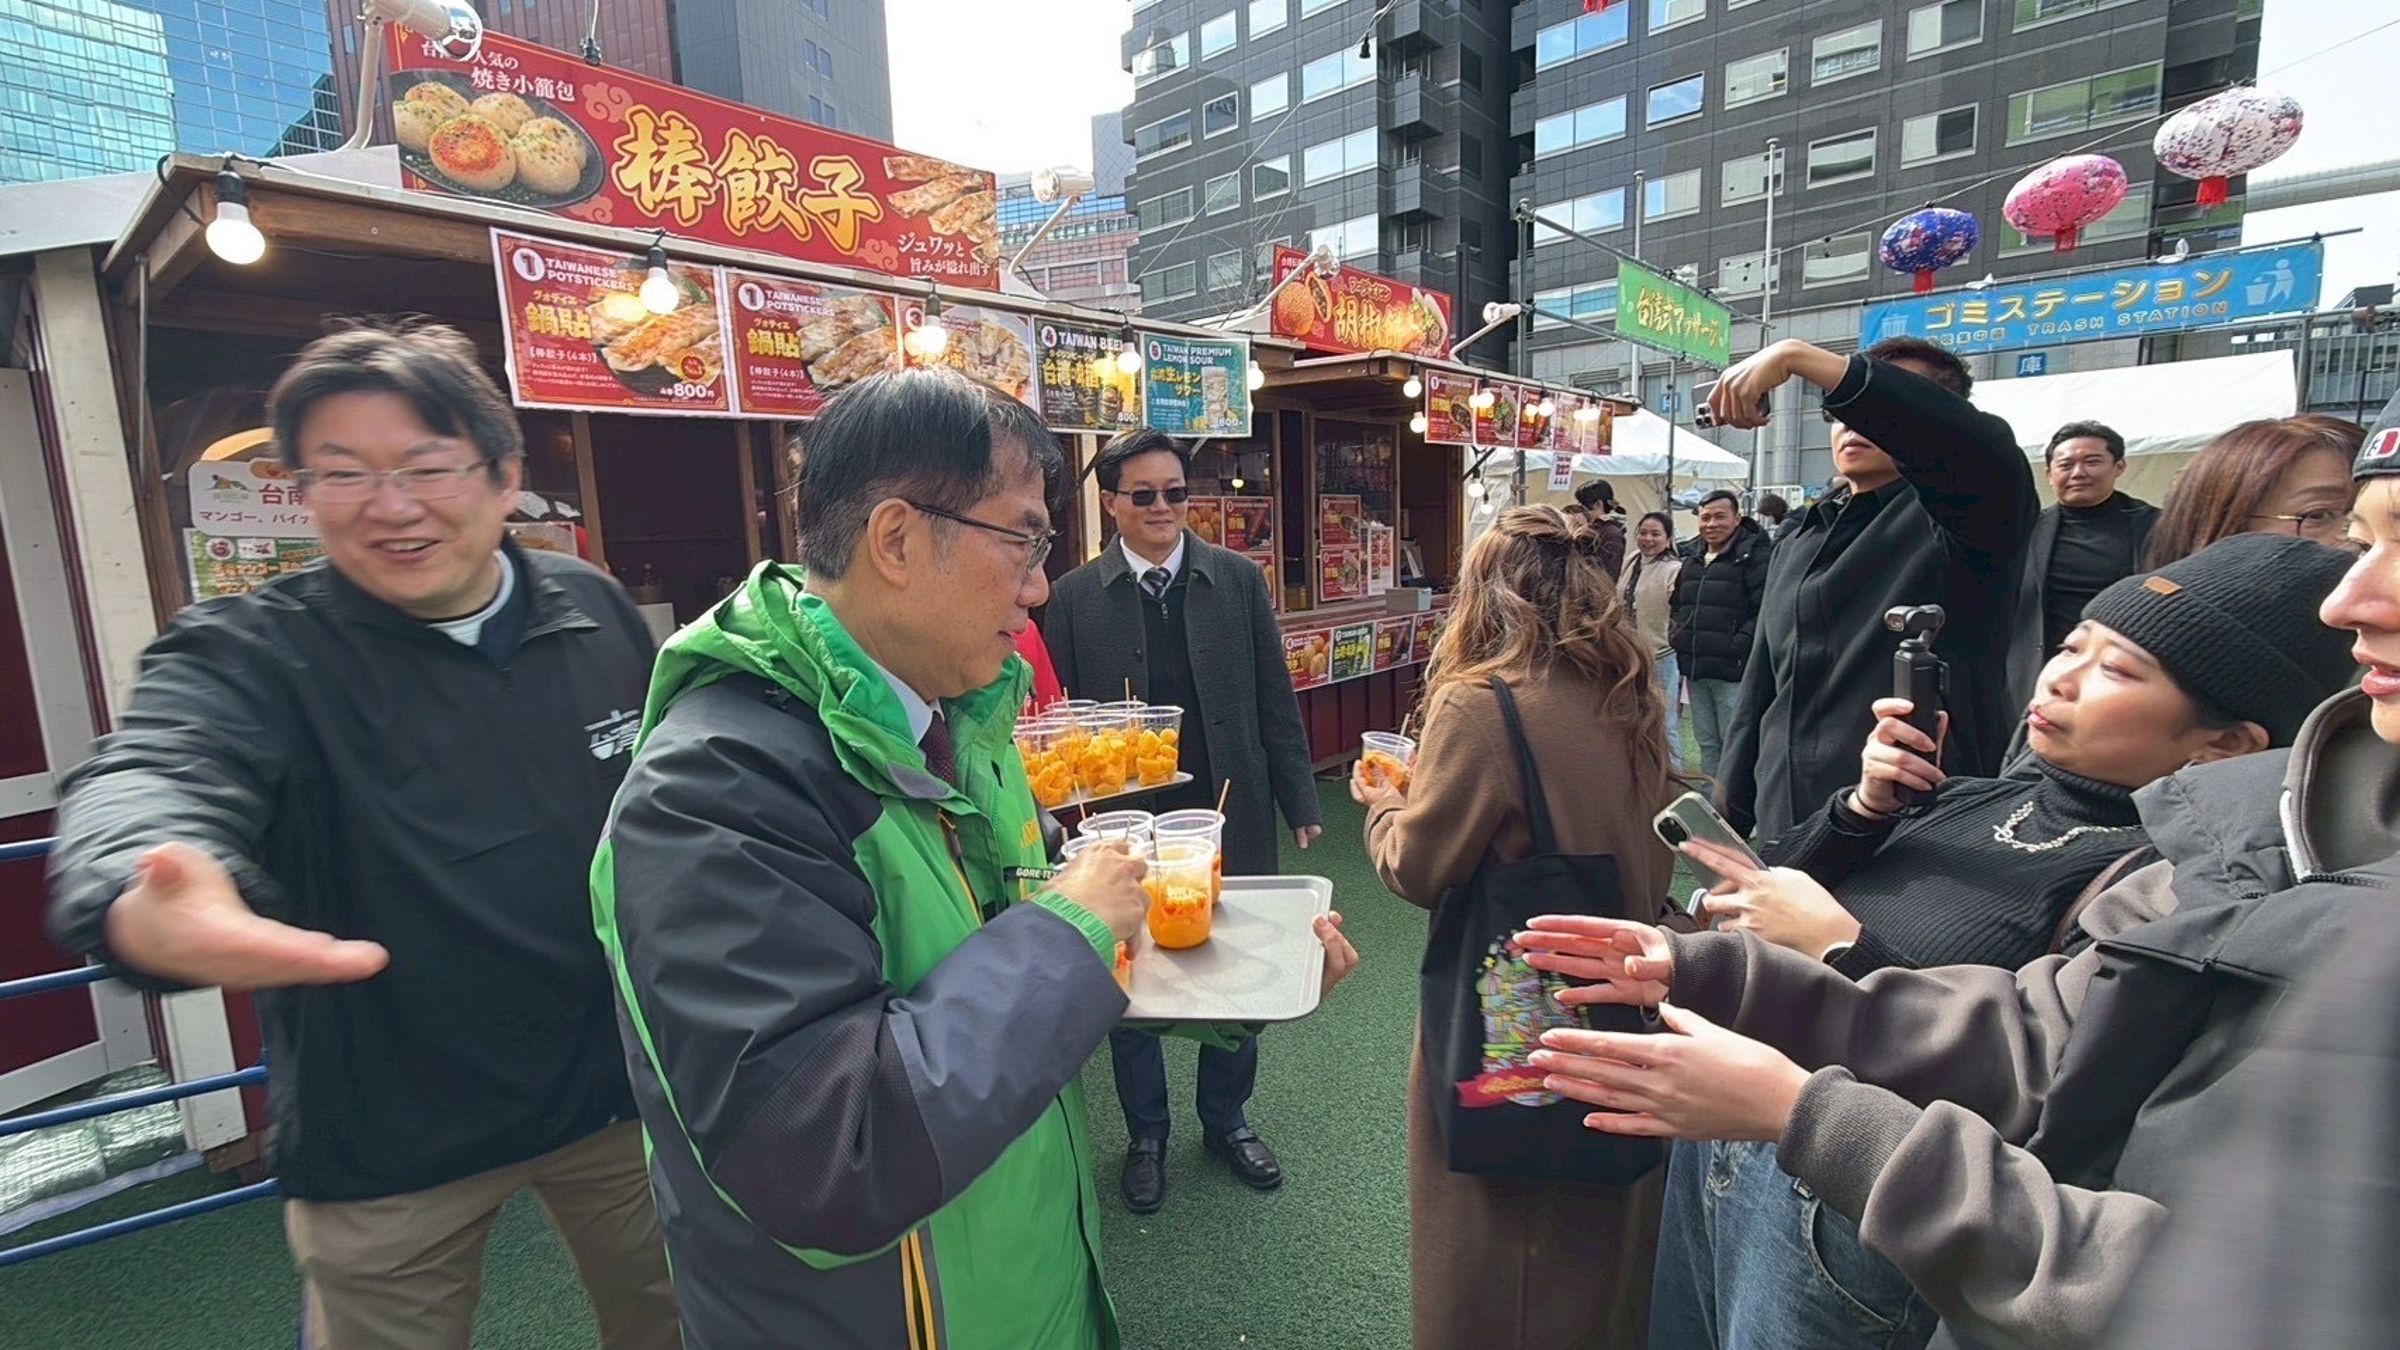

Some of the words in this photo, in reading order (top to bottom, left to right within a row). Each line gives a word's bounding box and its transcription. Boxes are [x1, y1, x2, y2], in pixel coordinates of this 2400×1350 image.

[470, 66, 575, 102] 焼き小籠包
[615, 108, 882, 252] 棒餃子
[898, 232, 965, 257] ジュワッと
[521, 252, 536, 276] 1
[545, 258, 618, 278] TAIWANESE
[910, 257, 990, 276] 旨みが溢れ出す
[547, 270, 635, 291] POTSTICKERS
[766, 290, 822, 305] TAIWANESE
[766, 301, 835, 317] POTSTICKERS
[1925, 267, 2232, 330] ゴミステーション
[524, 301, 592, 339] 鍋貼
[2027, 317, 2104, 335] TRASH
[2117, 300, 2228, 326] STATION
[747, 329, 800, 359] 鍋貼
[1058, 332, 1097, 349] TAIWAN
[1099, 337, 1123, 352] BEE
[1162, 344, 1189, 355] TAIWAN
[1190, 347, 1232, 357] PREMIUM
[1163, 354, 1188, 364] LEMON
[1190, 356, 1214, 365] SOUR
[2019, 355, 2042, 374] 庫
